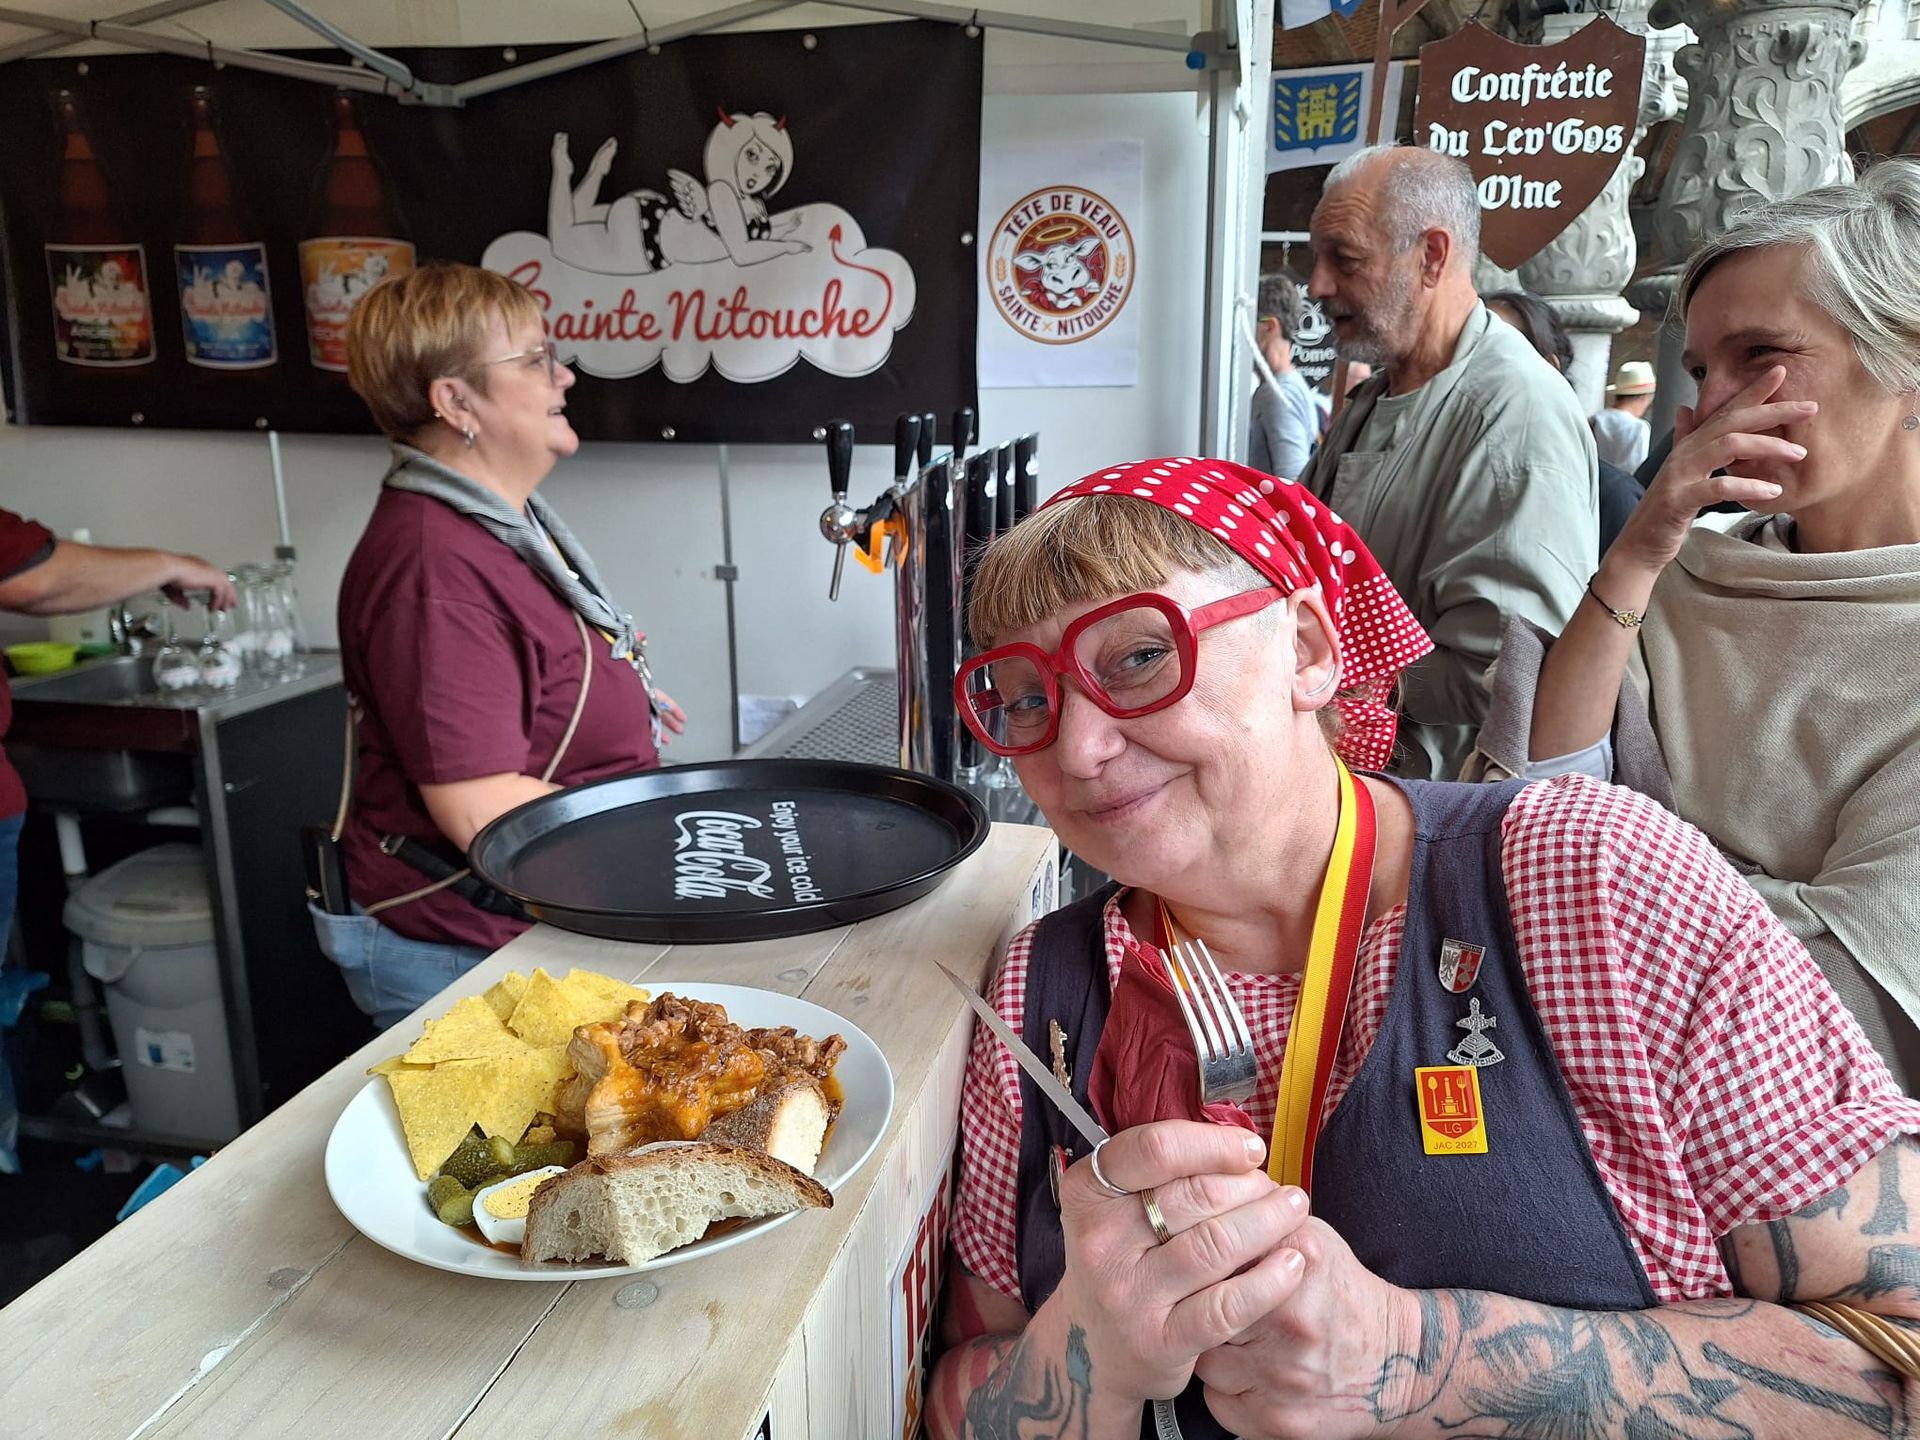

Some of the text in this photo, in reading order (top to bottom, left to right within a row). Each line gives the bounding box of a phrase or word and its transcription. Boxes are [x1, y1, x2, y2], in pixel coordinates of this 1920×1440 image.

[1451, 61, 1614, 107] Confrérie
[1428, 122, 1470, 157] du
[1477, 174, 1563, 210] Olne
[1050, 194, 1074, 211] DE
[1079, 198, 1121, 240] VEAU
[667, 277, 892, 343] Nitouche
[999, 282, 1124, 336] SAINTE NITOUCHE
[769, 801, 824, 902] Enjoy your ice cold
[1433, 1140, 1478, 1150] JAC 2027
[1444, 1122, 1463, 1134] LG
